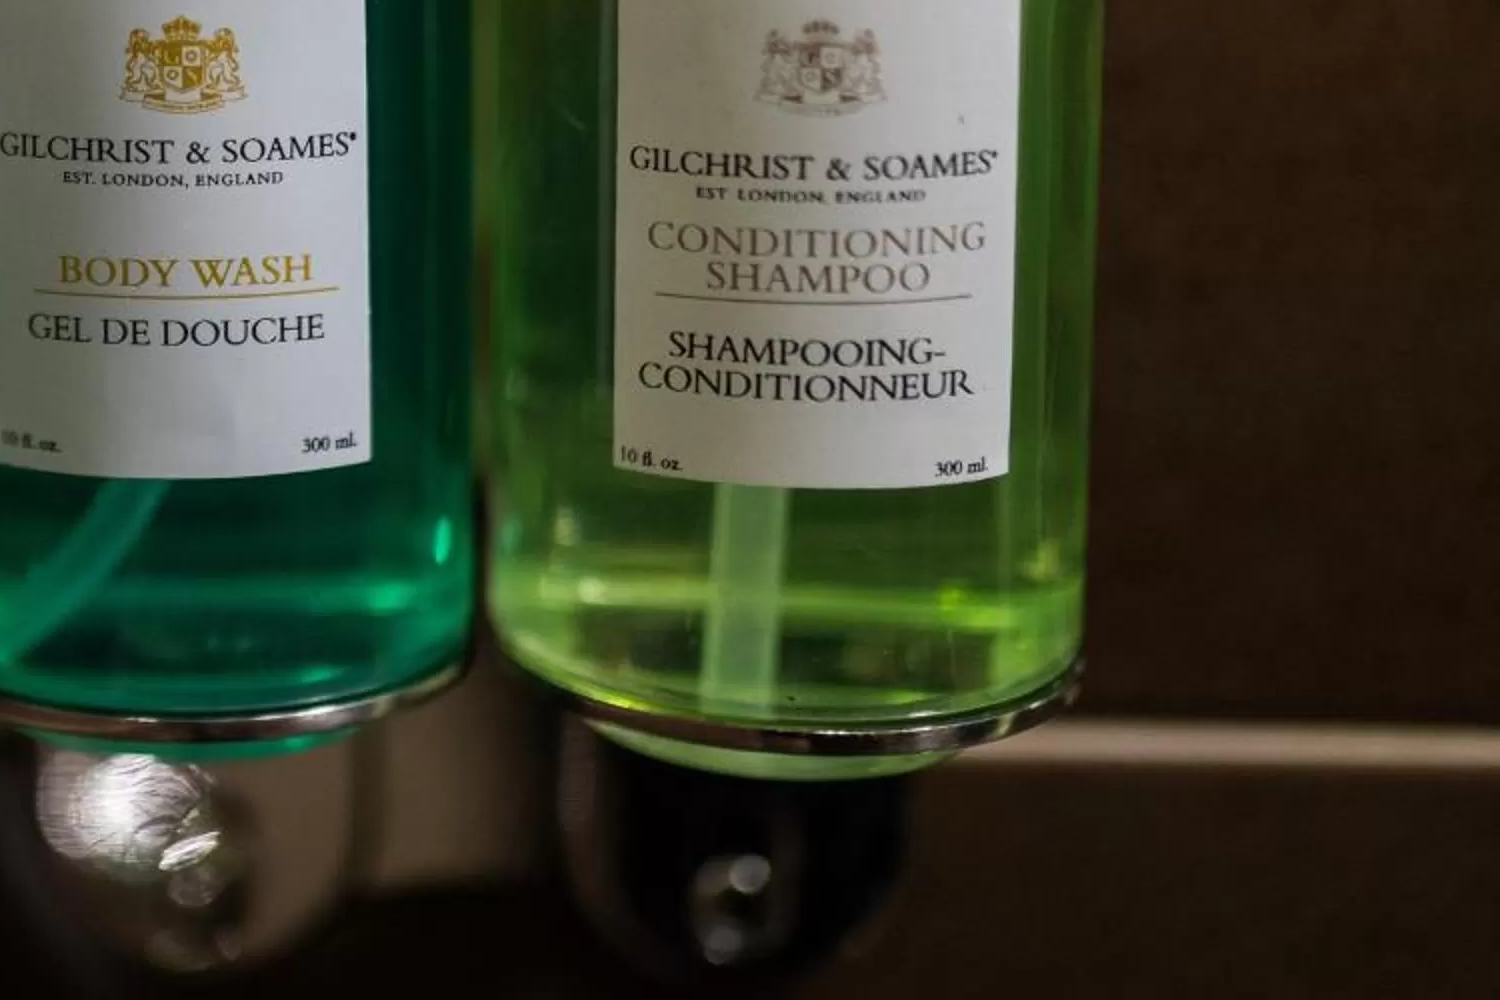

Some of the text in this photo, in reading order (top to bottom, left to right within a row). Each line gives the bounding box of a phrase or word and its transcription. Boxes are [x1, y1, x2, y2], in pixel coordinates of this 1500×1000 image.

[0, 131, 174, 164] GILCHRIST
[186, 140, 210, 164] &
[629, 145, 815, 181] GILCHRIST
[826, 158, 851, 181] &
[62, 171, 284, 189] EST. LONDON, ENGLAND
[835, 189, 927, 204] ENGLAND
[647, 221, 986, 259] CONDITIONING
[58, 254, 313, 287] BODY WASH
[706, 262, 930, 294] SHAMPOO
[28, 314, 325, 347] GEL DE DOUCHE
[668, 331, 946, 368] SHAMPOOING-
[638, 362, 974, 402] CONDITIONNEUR
[301, 436, 331, 454] 300
[621, 445, 637, 464] 10
[934, 460, 963, 477] 300
